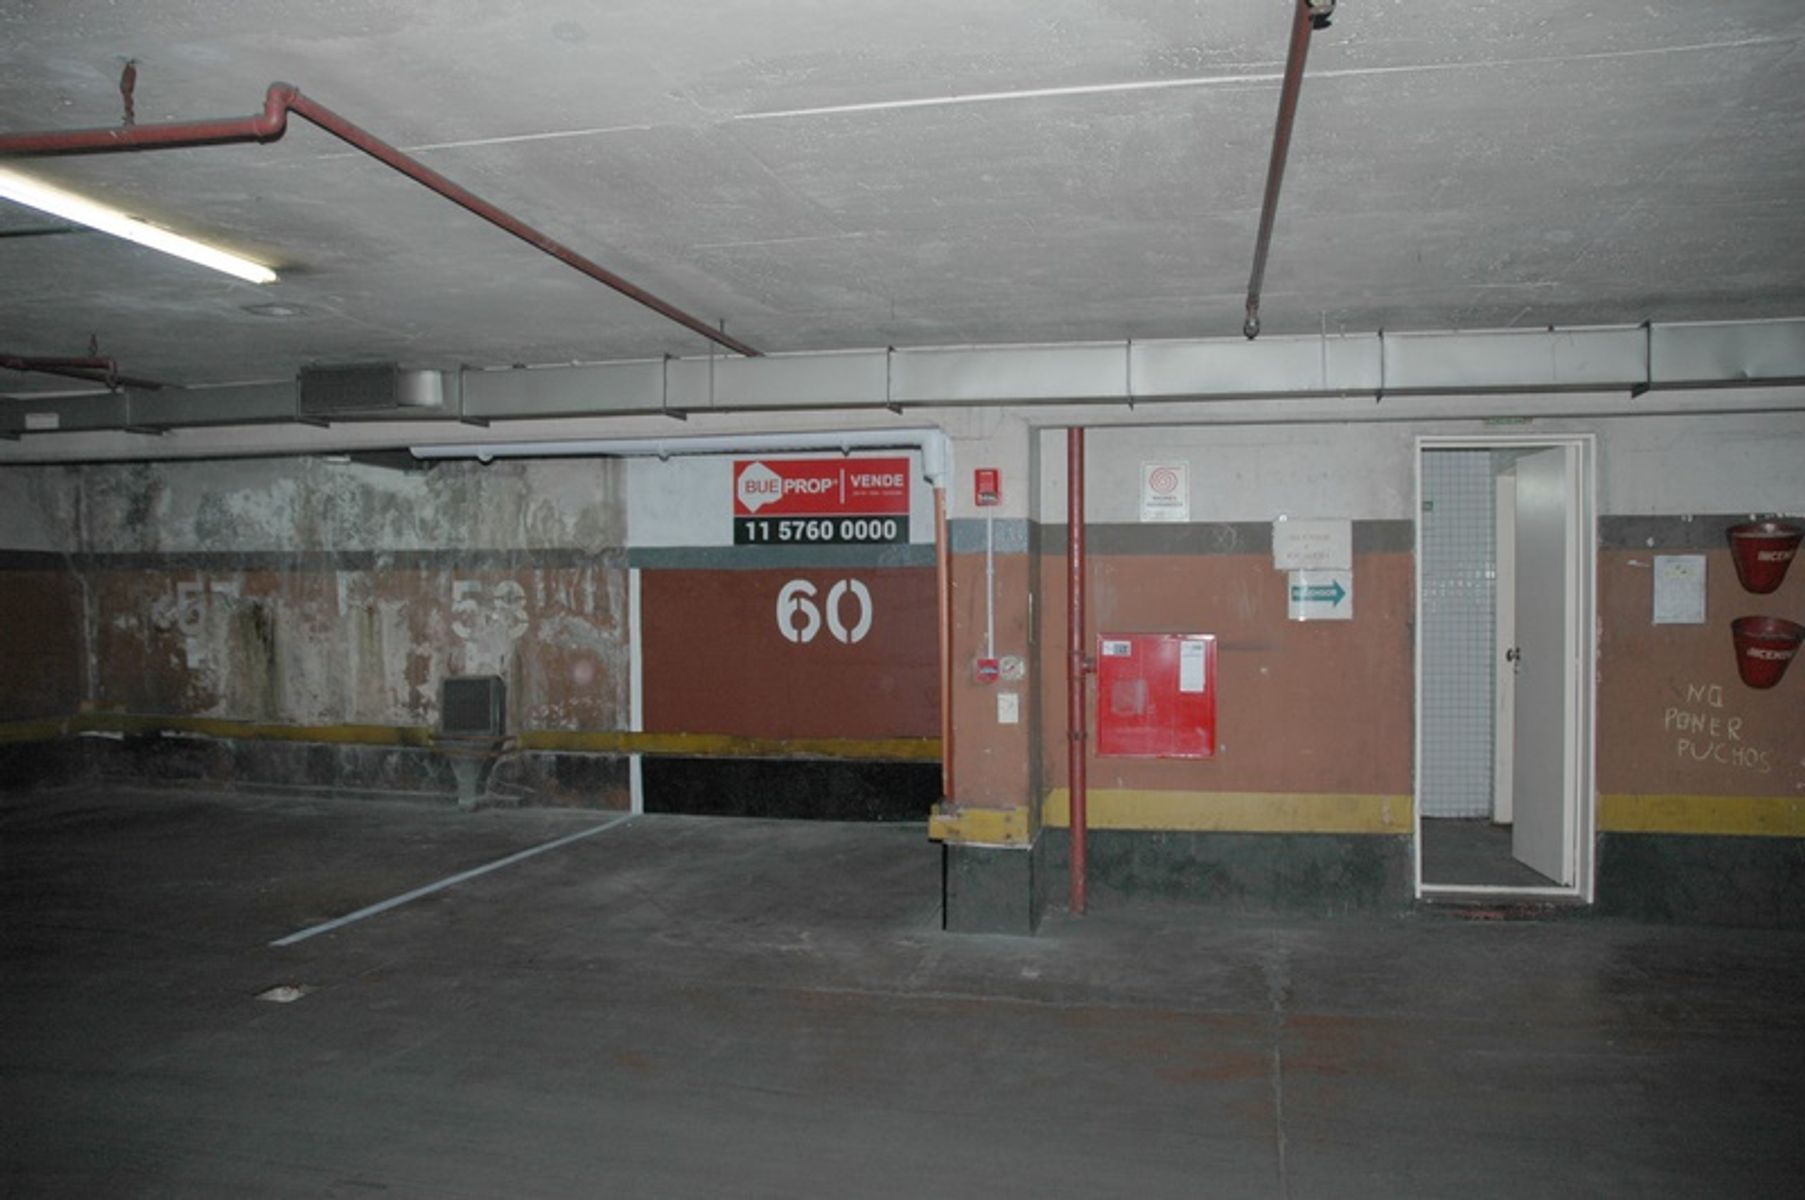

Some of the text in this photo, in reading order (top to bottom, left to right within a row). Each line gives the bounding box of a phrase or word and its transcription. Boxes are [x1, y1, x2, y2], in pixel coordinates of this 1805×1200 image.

[850, 474, 903, 487] VENDE
[745, 519, 897, 541] 11 5760 0000
[776, 579, 873, 644] 60
[1686, 683, 1723, 708] NO
[1665, 707, 1743, 740] PONER
[1678, 738, 1772, 773] PUCHOS
